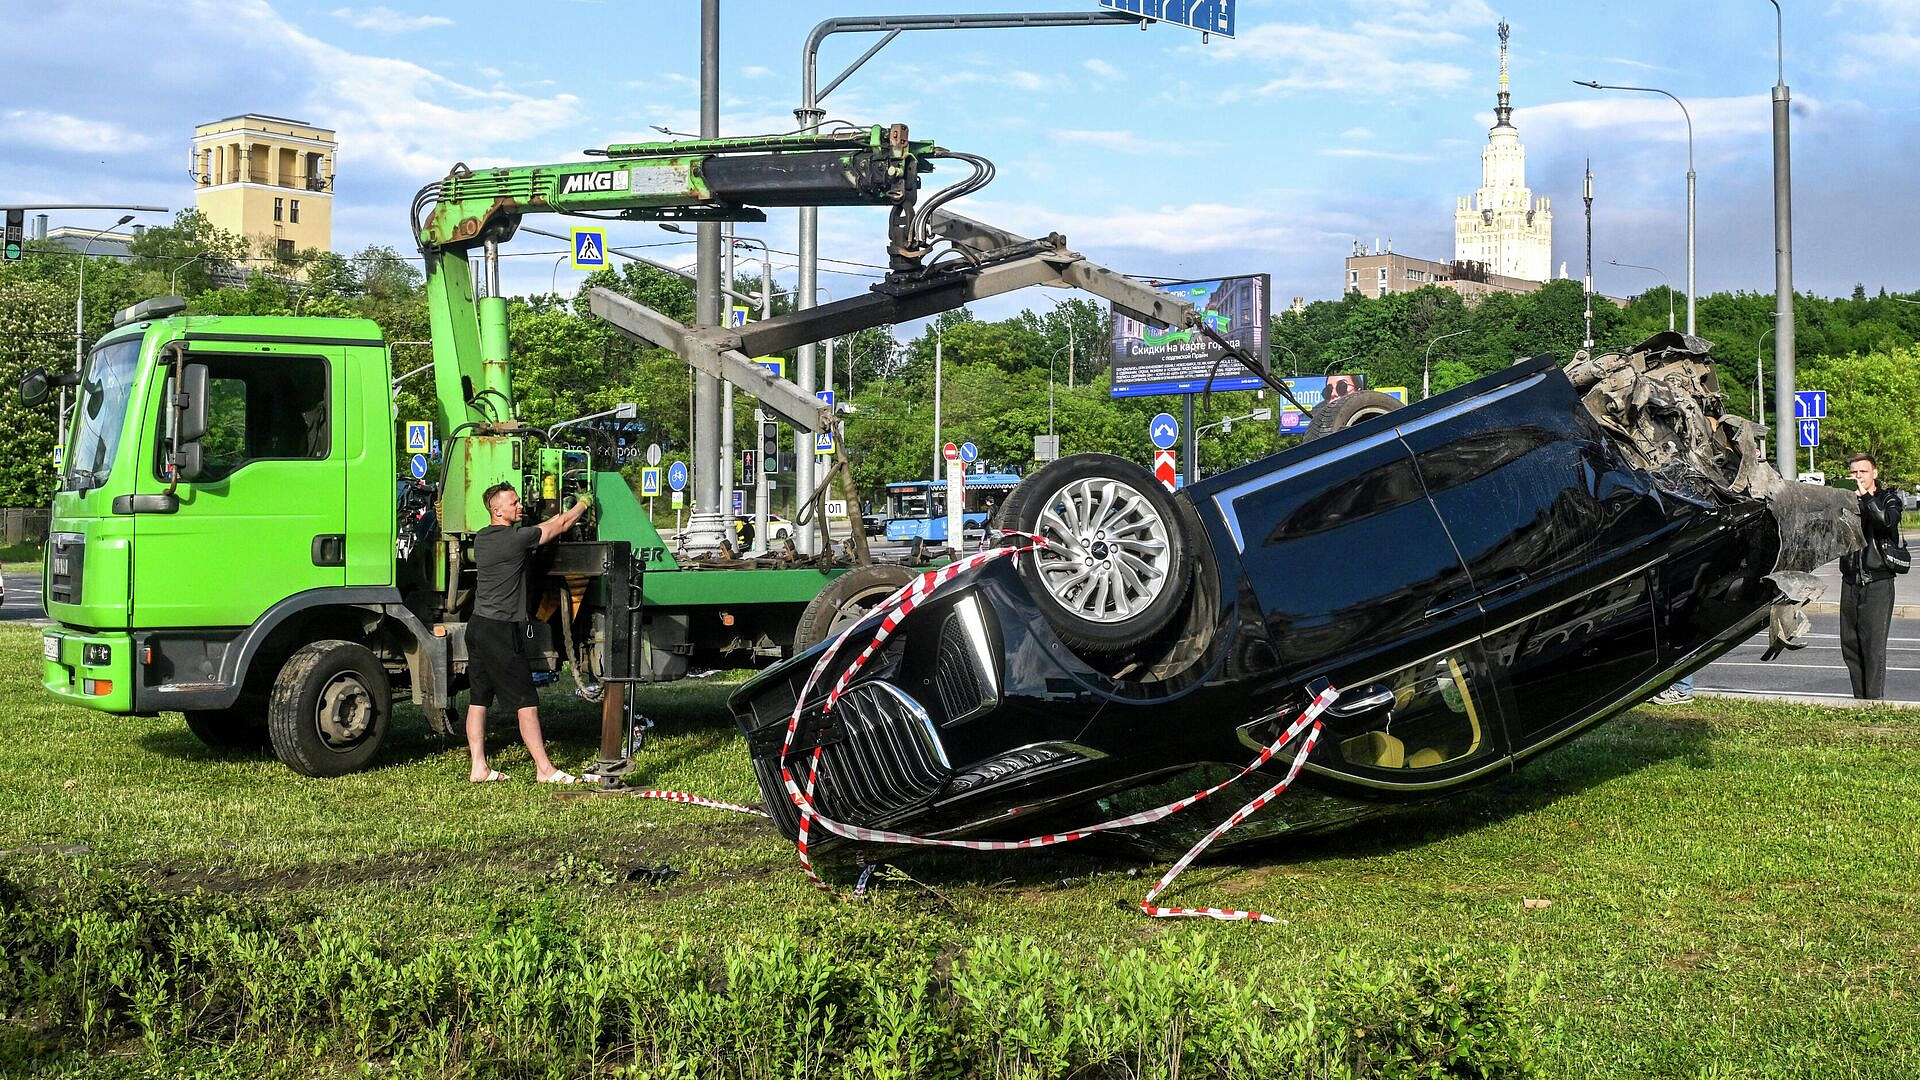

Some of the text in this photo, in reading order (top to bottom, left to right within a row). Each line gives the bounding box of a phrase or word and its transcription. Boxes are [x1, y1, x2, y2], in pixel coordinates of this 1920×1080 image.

[562, 172, 611, 194] MKG
[1132, 339, 1240, 356] Скидки на карте горда
